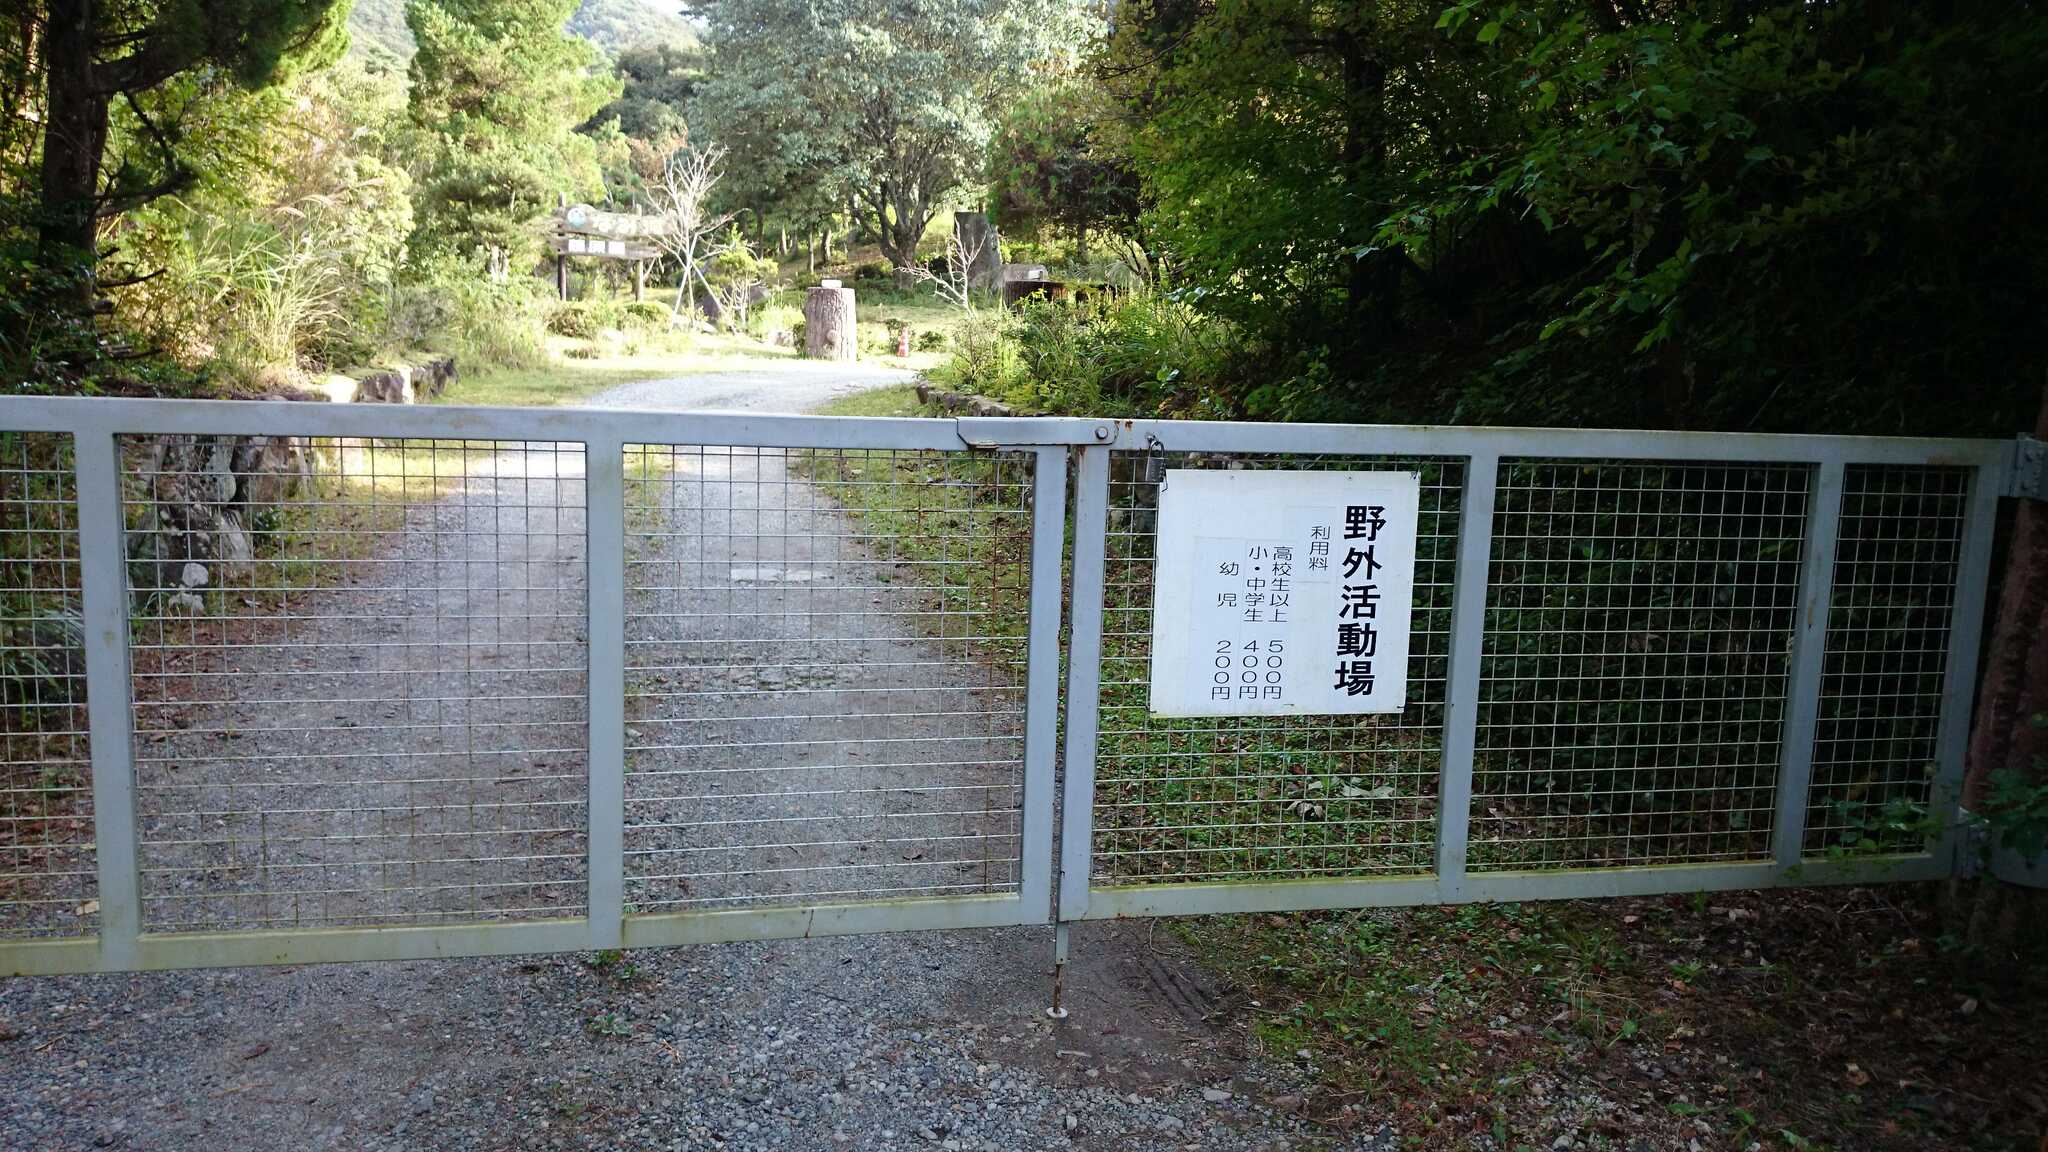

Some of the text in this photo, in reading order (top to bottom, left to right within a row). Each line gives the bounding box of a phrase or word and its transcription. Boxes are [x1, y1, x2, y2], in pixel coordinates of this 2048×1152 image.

[1239, 546, 1268, 700] 小・中学生 400円
[1263, 546, 1293, 700] 高校生以上 500円
[1308, 525, 1331, 571] 利用料
[1334, 505, 1387, 697] 野外活動場
[1211, 562, 1239, 700] 幼児 200円
